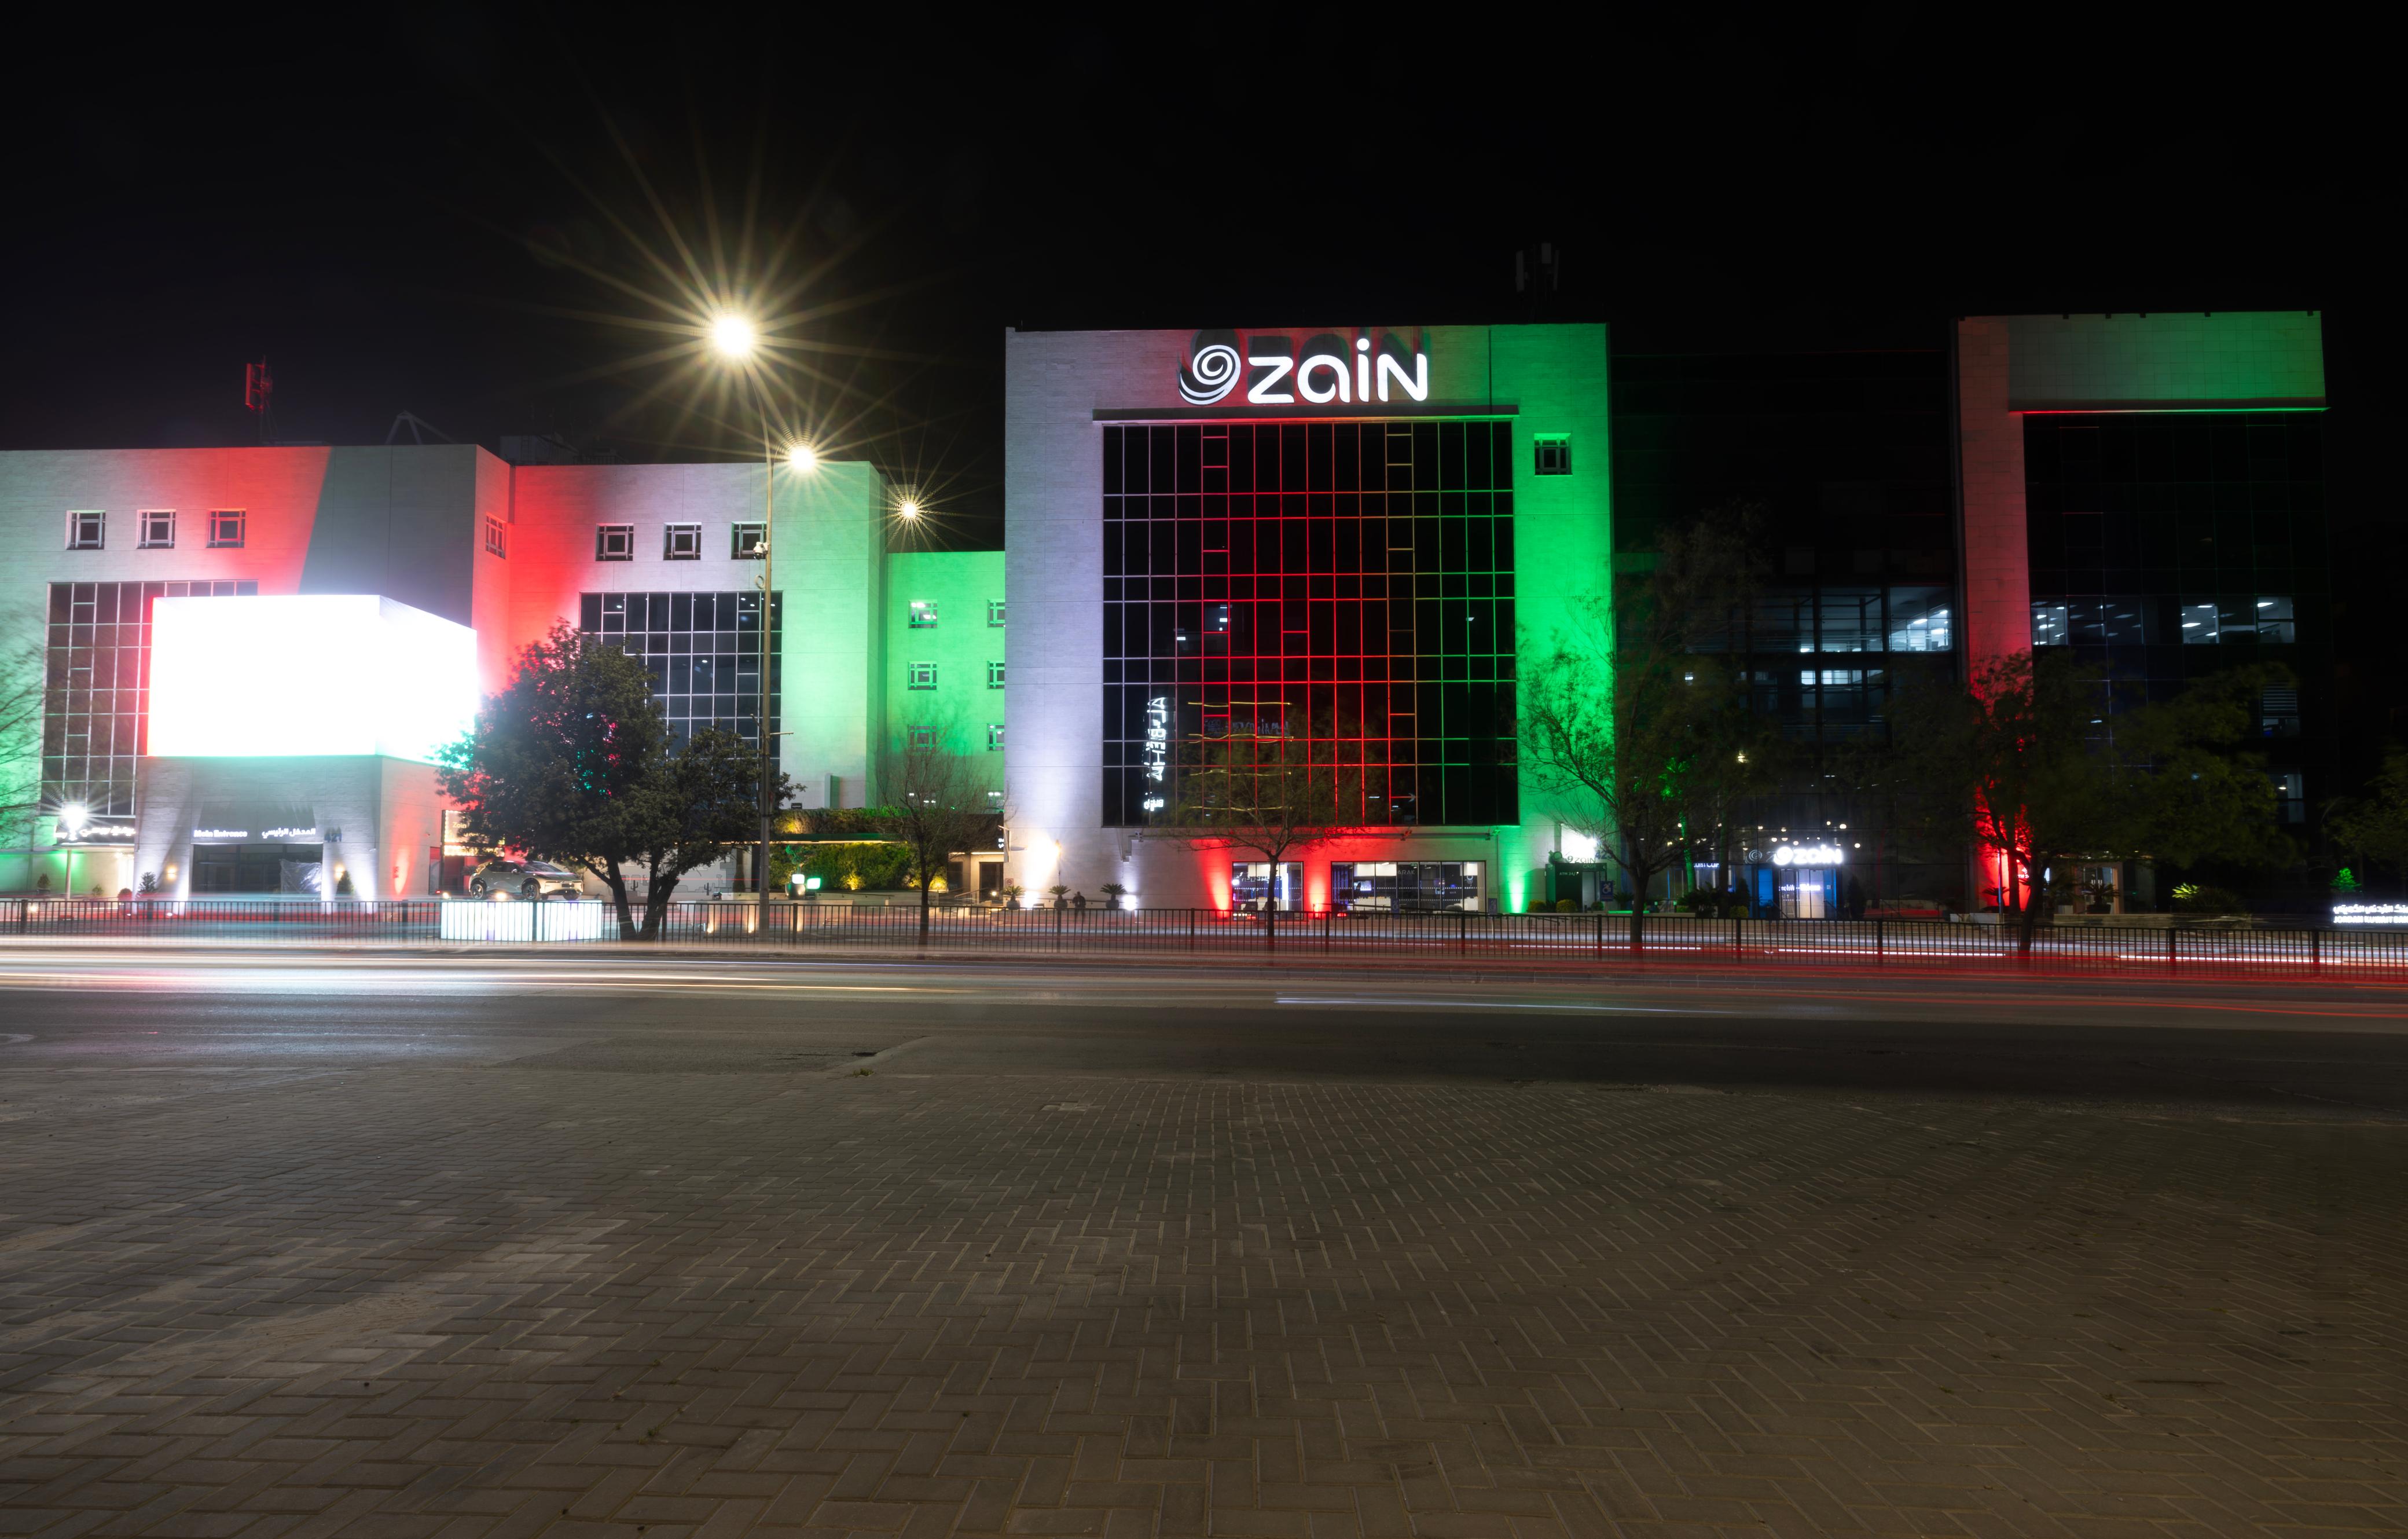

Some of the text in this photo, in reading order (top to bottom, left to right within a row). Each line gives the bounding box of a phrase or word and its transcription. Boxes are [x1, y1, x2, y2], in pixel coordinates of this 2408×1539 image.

[1247, 338, 1428, 404] zain
[289, 828, 316, 837] المدخل
[1793, 844, 1843, 864] zain
[2364, 915, 2393, 924] KUWAIT
